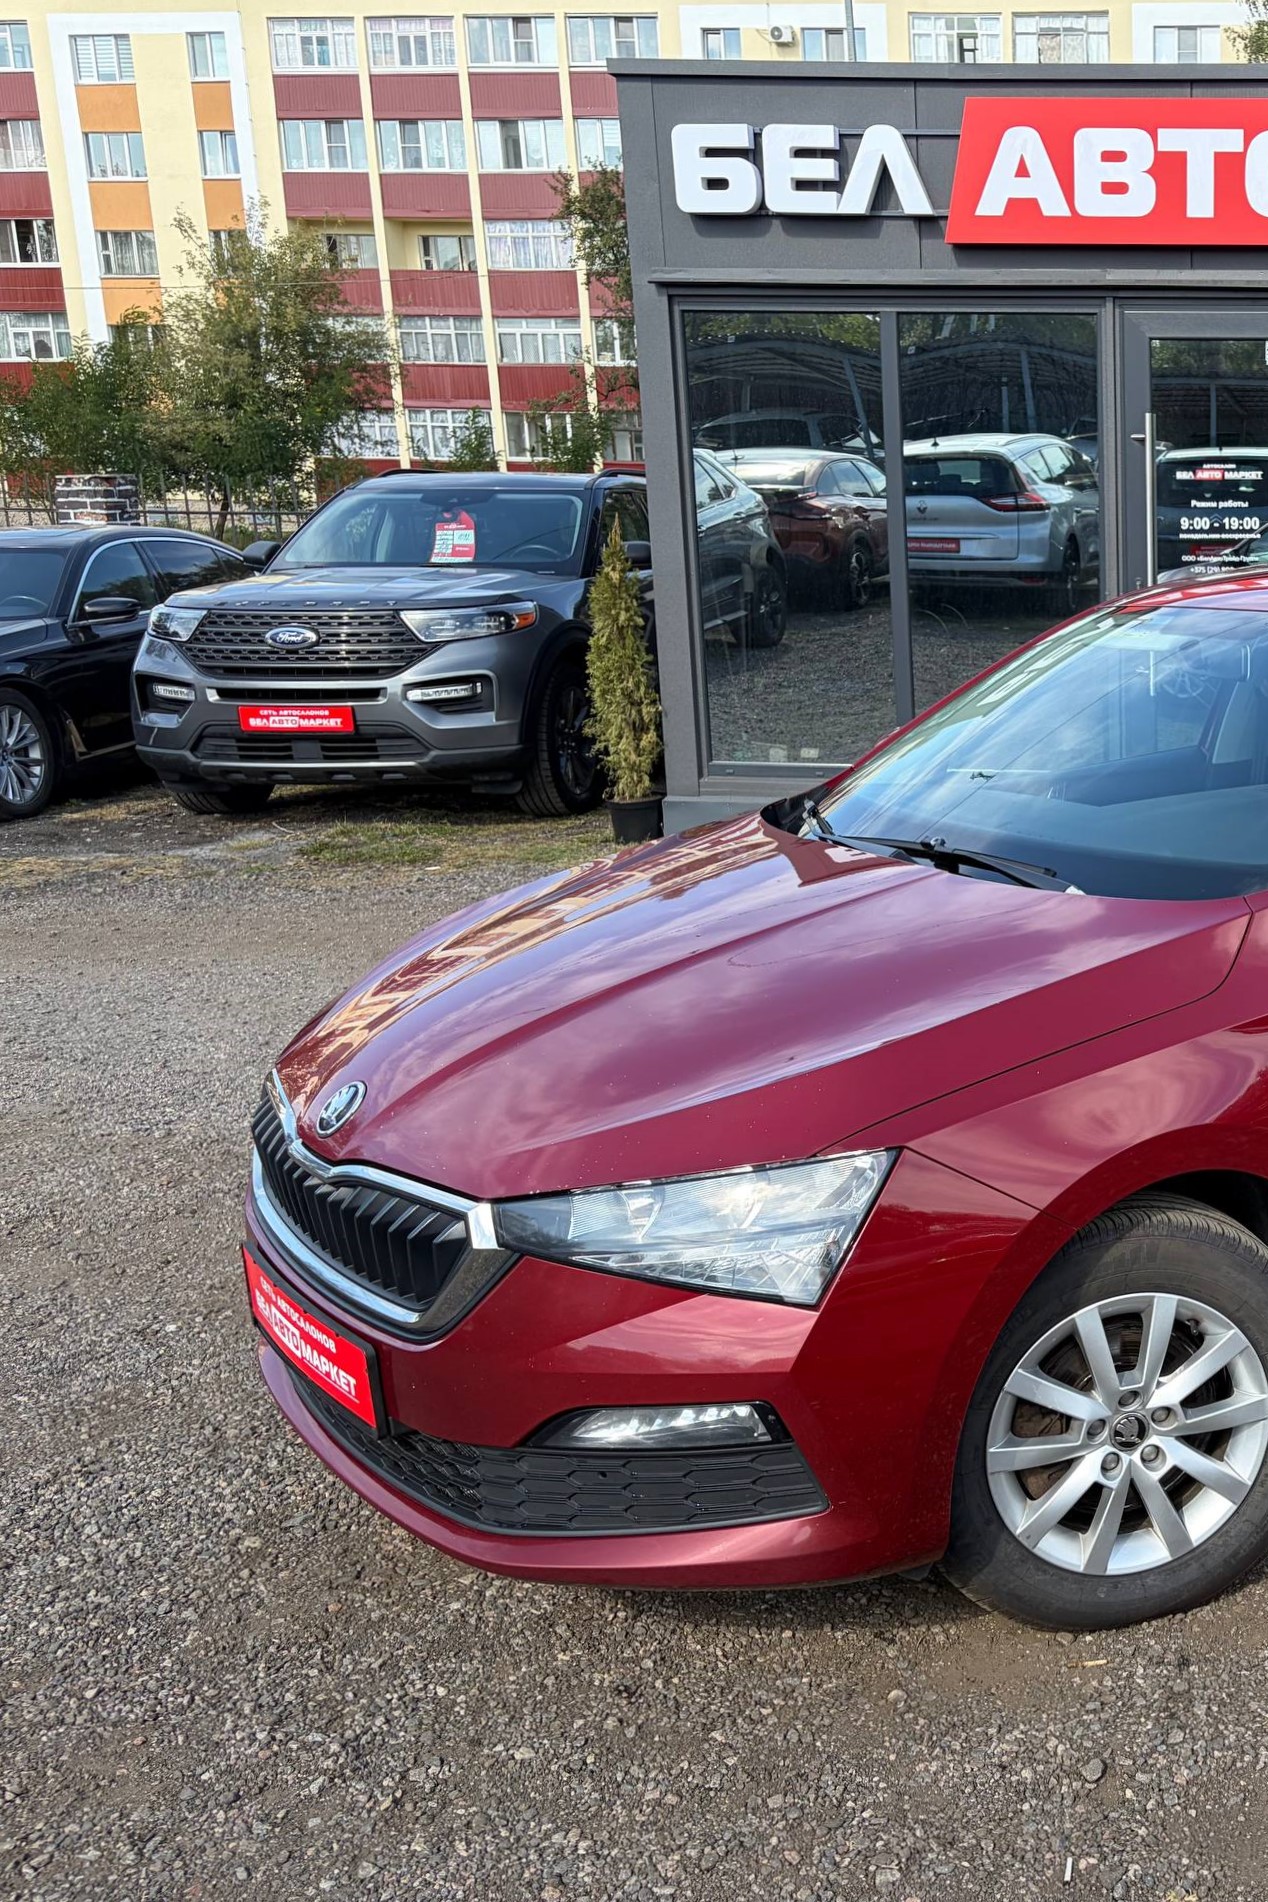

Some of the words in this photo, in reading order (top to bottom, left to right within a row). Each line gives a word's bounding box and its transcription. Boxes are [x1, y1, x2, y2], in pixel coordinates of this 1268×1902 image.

[670, 123, 935, 216] БЕЛ
[1224, 471, 1264, 480] МАРКЕТ
[1190, 499, 1218, 508] Режим
[1218, 499, 1249, 509] работы
[1180, 516, 1210, 530] 9:00
[1223, 516, 1260, 530] 19:00
[276, 631, 304, 643] Ford
[277, 1297, 337, 1354] АВТОСАЛОНОВ
[301, 1342, 357, 1397] МАРКЕТ
